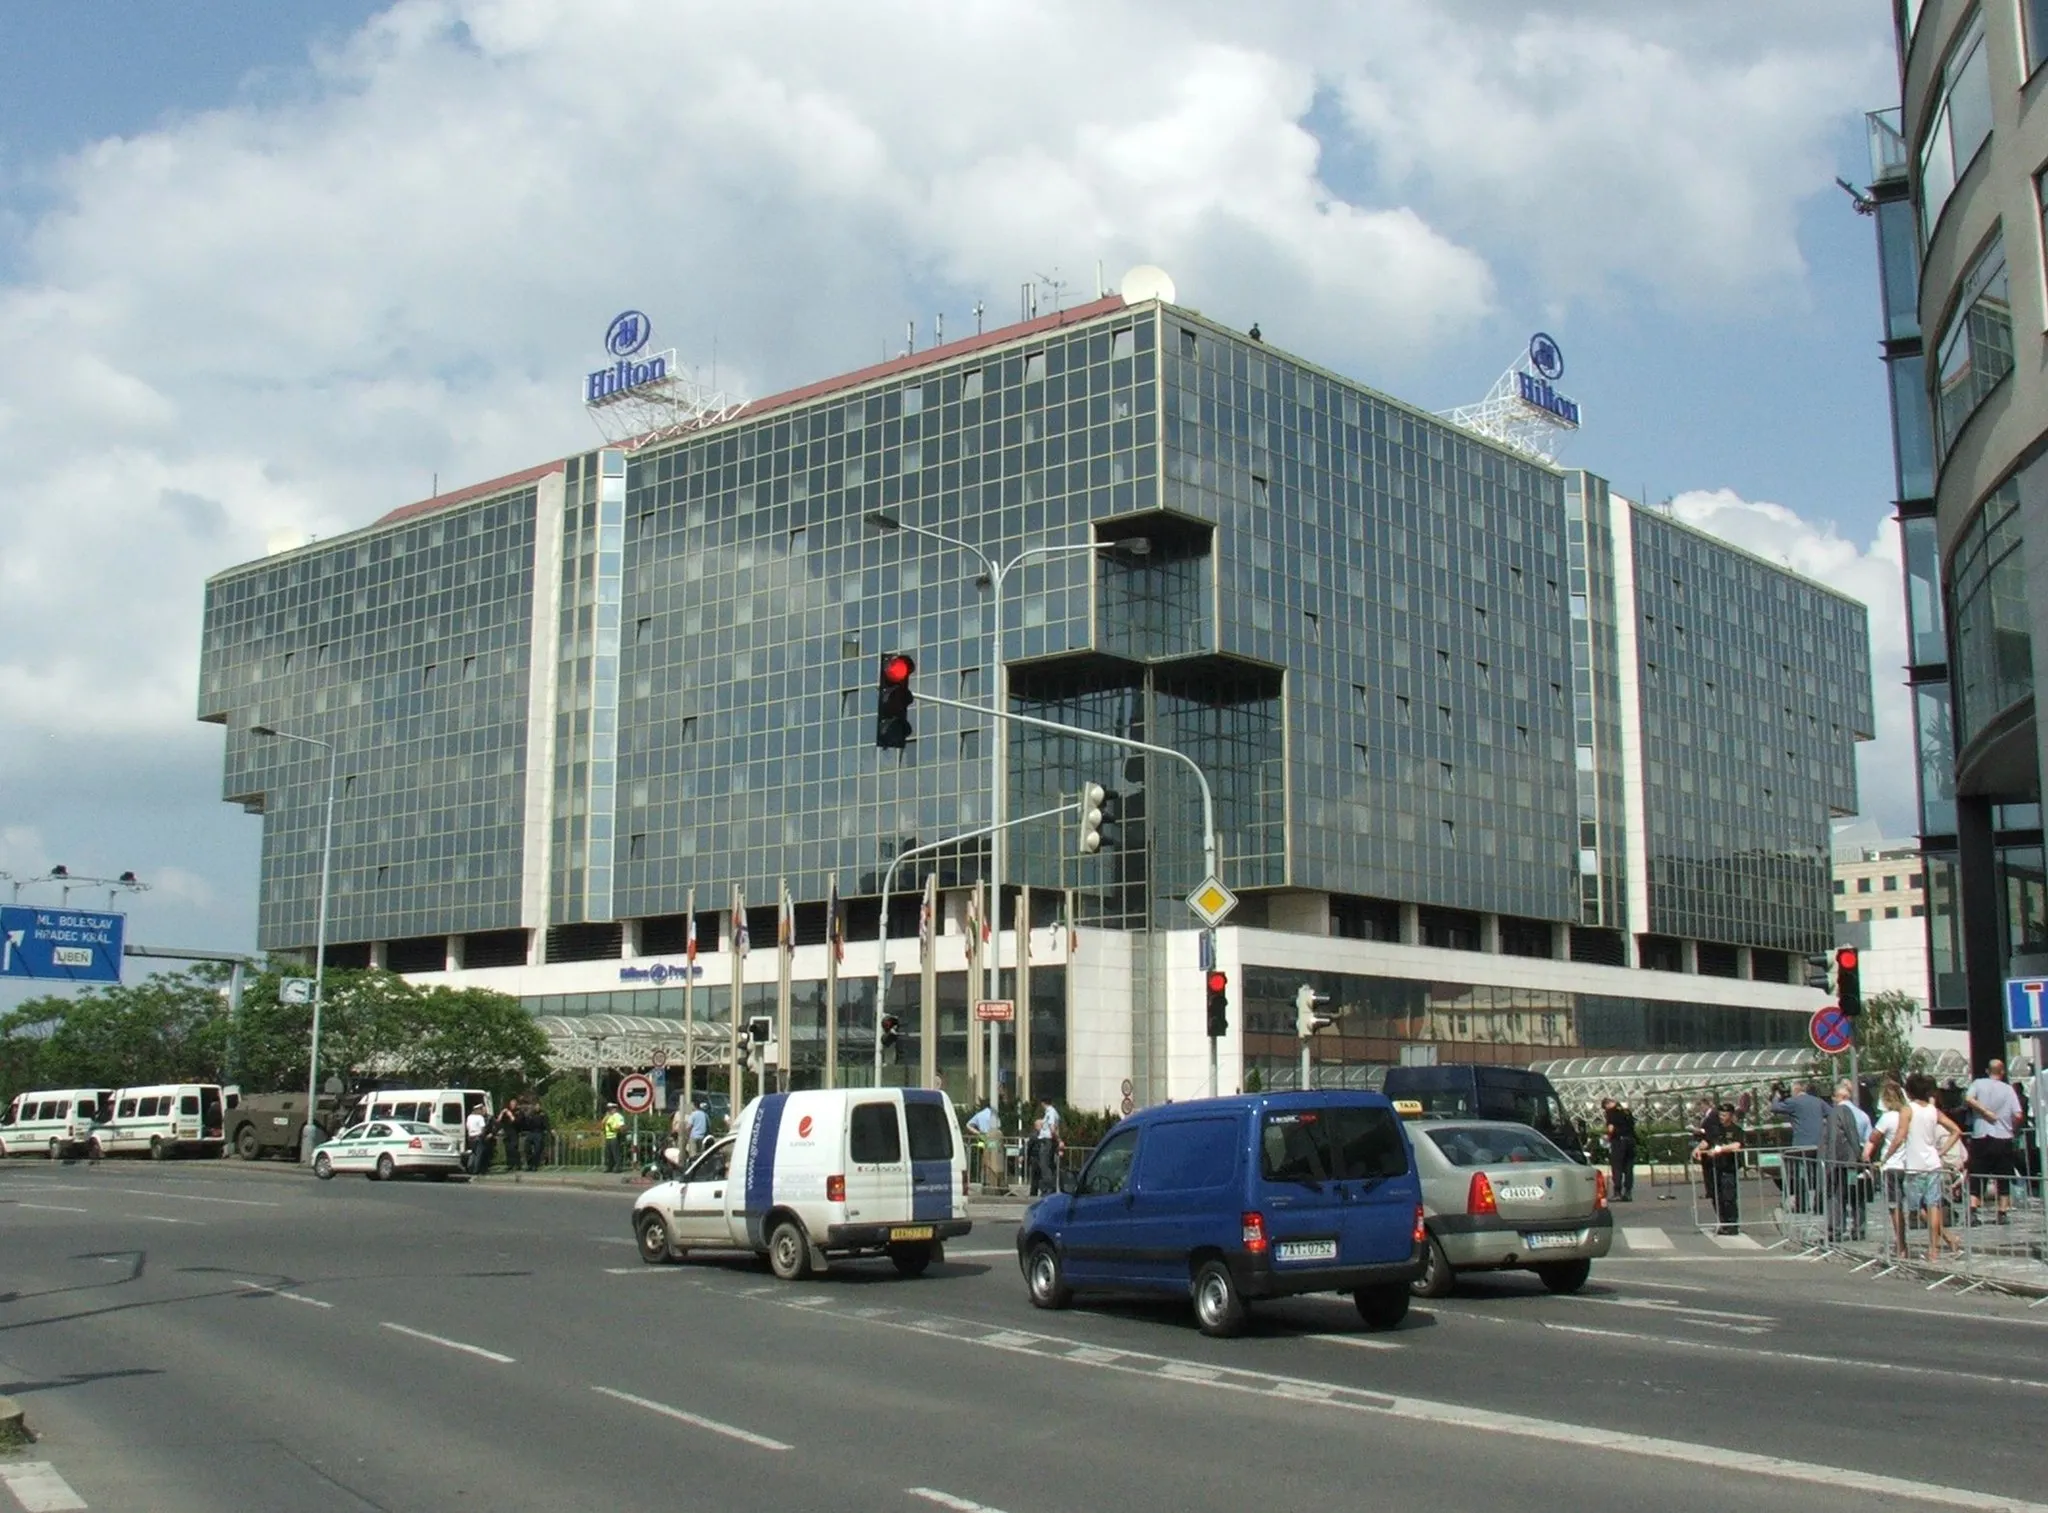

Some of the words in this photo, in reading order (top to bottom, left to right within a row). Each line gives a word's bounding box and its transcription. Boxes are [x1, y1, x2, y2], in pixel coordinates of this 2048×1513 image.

[587, 357, 666, 401] Hilton
[1518, 371, 1579, 425] Hilton
[35, 929, 78, 941] HRADEC
[59, 915, 113, 929] BOLESLAV
